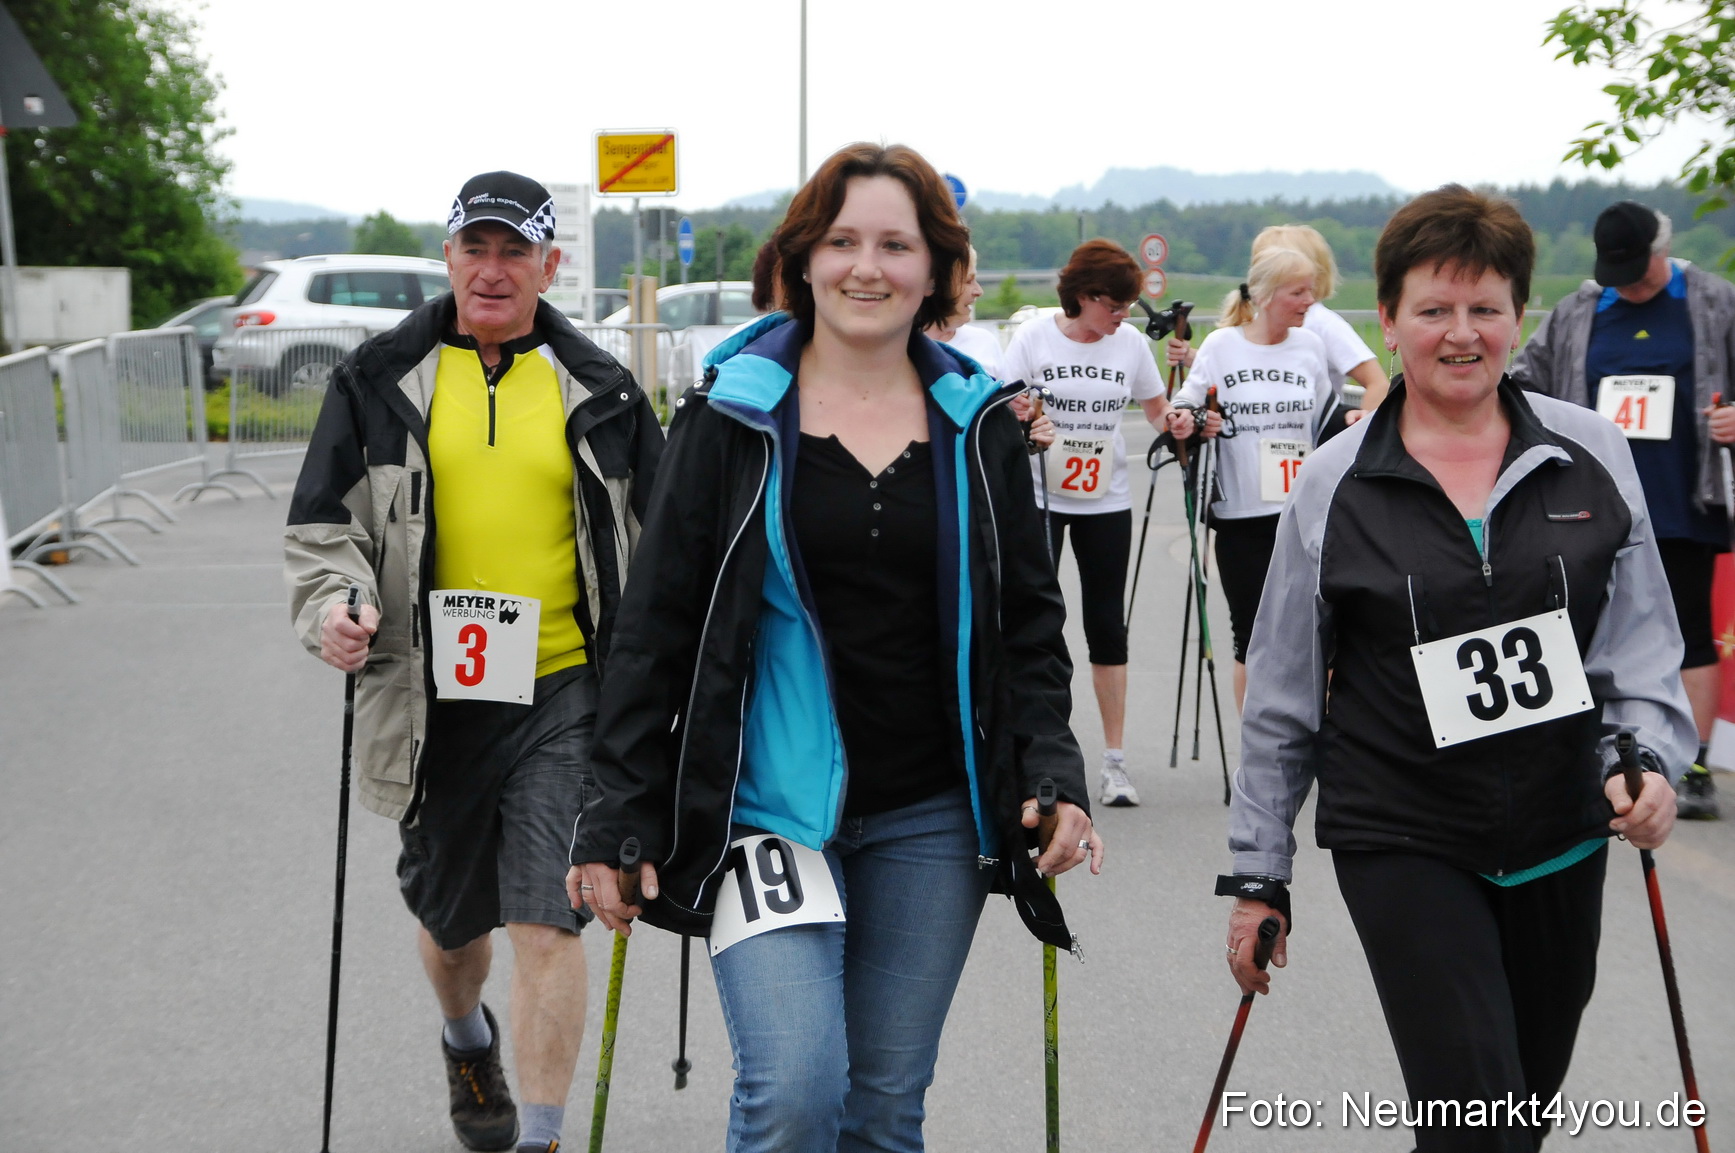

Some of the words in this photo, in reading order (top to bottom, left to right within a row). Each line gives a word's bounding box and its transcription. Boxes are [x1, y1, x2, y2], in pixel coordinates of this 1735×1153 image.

[1043, 365, 1125, 386] BERGER
[1223, 369, 1307, 389] BERGER
[1091, 396, 1127, 413] GIRLS
[1275, 399, 1313, 413] GIRLS
[1614, 395, 1649, 430] 41
[1076, 422, 1092, 430] and
[1063, 439, 1093, 449] MEYER
[1061, 456, 1101, 493] 23
[443, 595, 496, 610] MEYER
[442, 608, 496, 620] WERBUNG
[455, 623, 488, 687] 3
[1456, 626, 1554, 722] 33
[726, 837, 805, 924] 19
